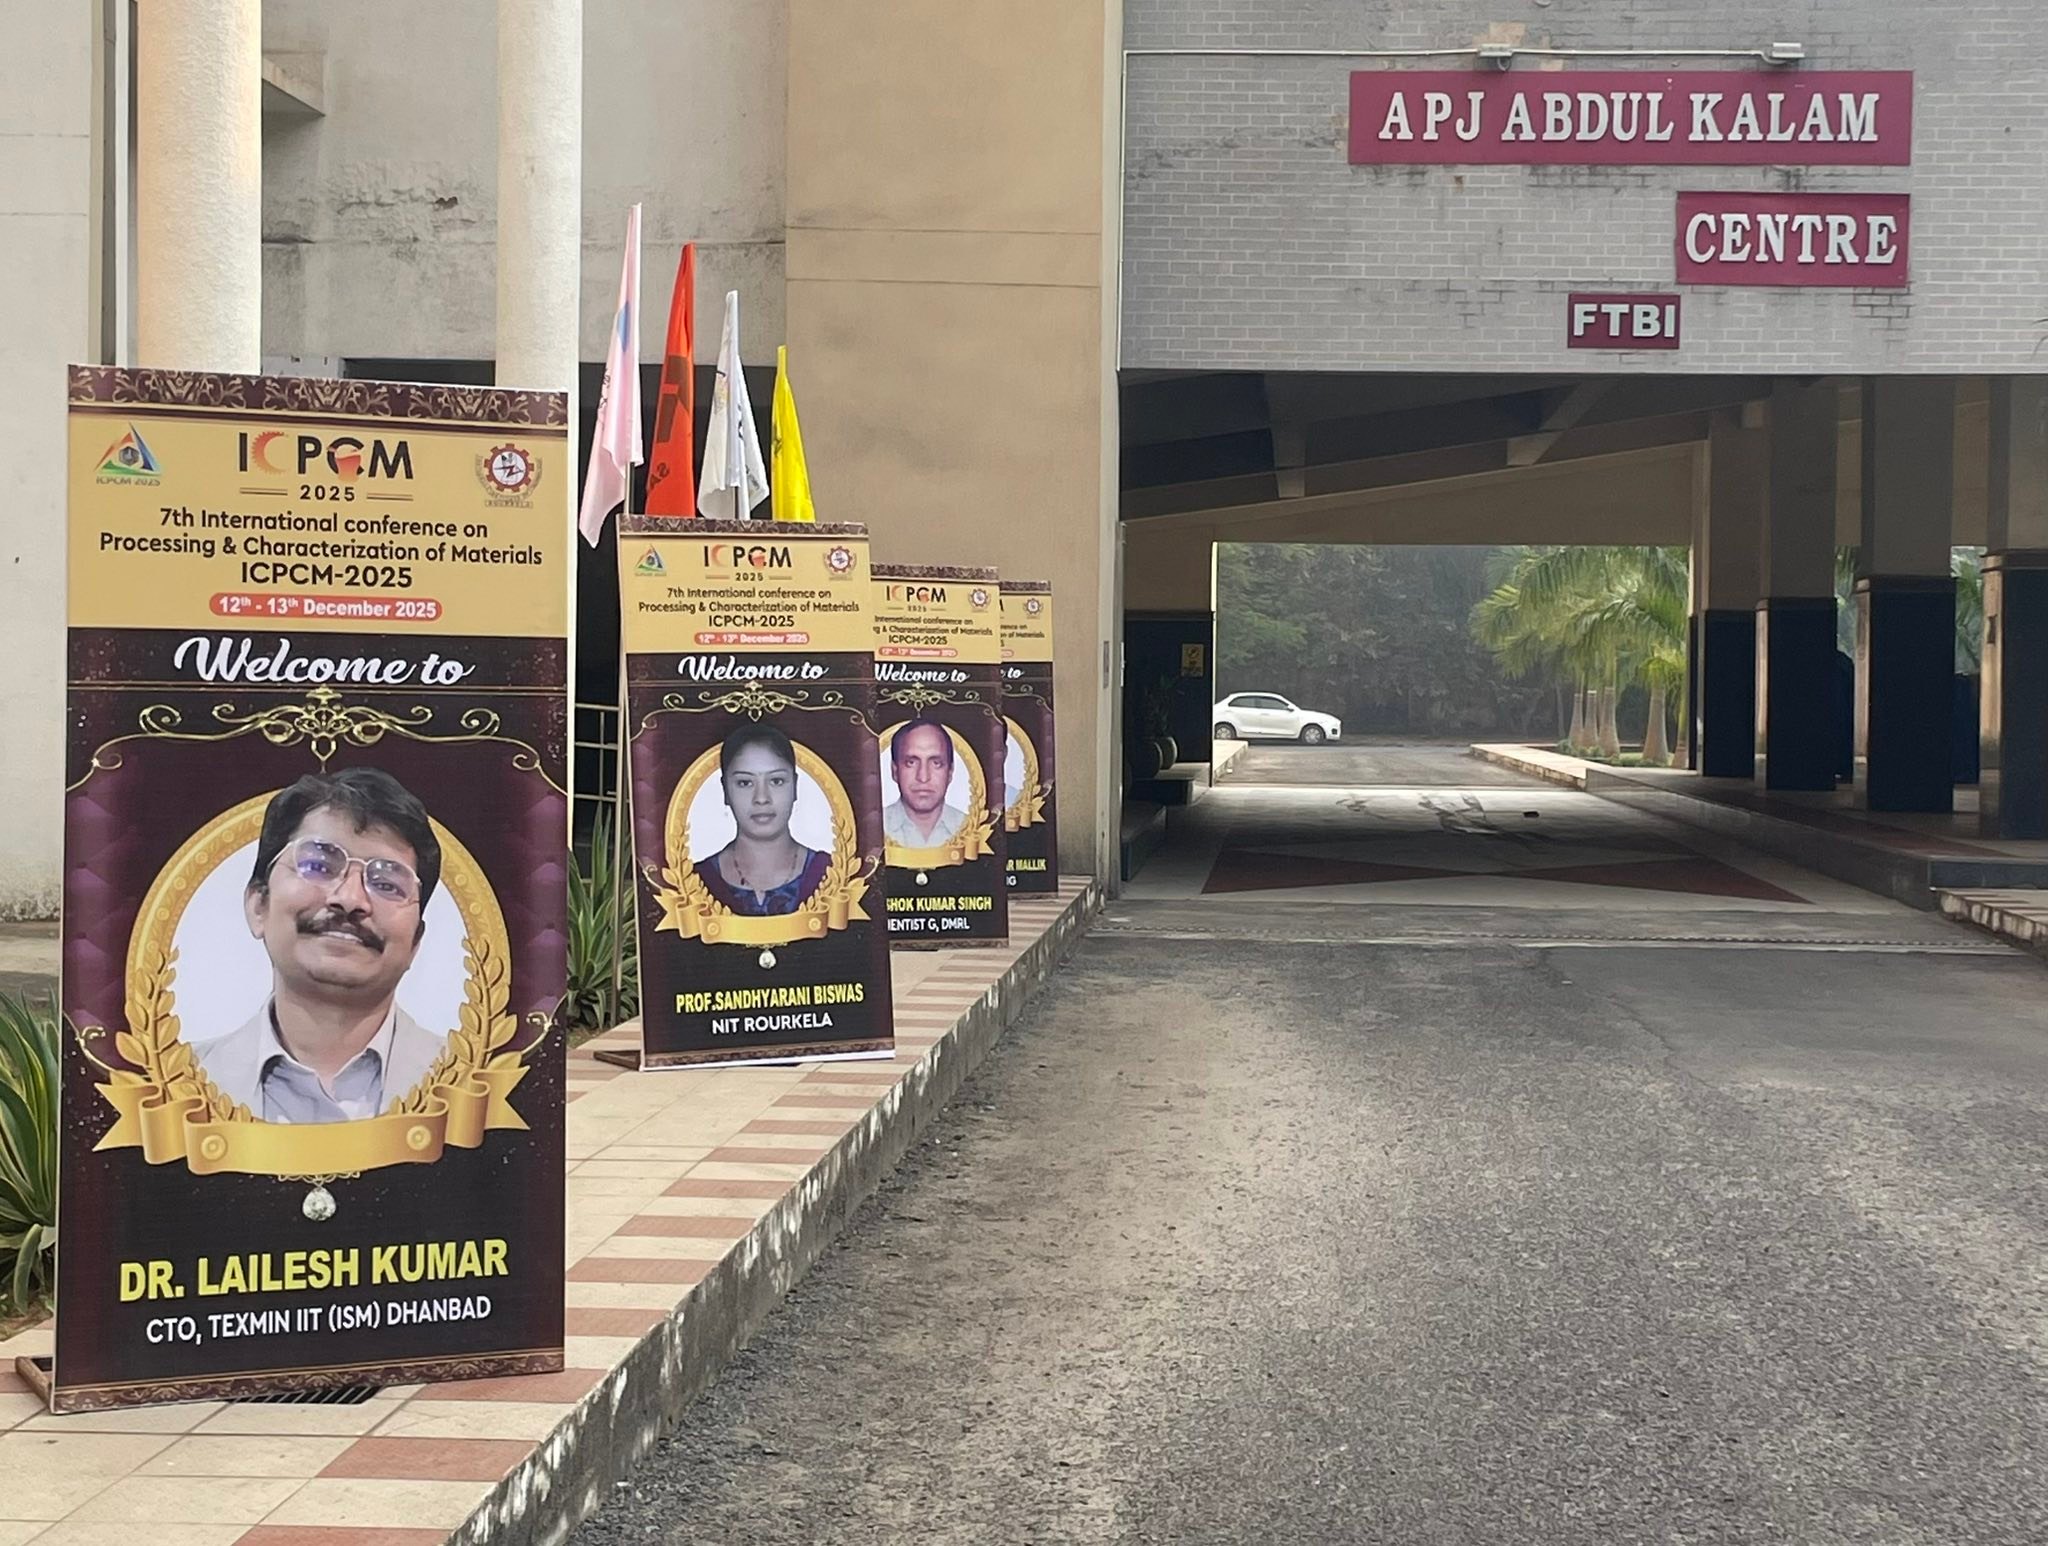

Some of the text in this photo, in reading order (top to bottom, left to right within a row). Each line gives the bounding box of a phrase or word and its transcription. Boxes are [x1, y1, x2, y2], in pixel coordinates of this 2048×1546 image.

[1378, 91, 1880, 143] APJ ABDUL KALAM
[1684, 213, 1898, 264] CENTRE
[1572, 303, 1676, 339] FTBI
[300, 485, 355, 502] 2025
[160, 507, 488, 538] 7th International conference on
[100, 532, 543, 565] Processing & Characterization of Materials
[241, 562, 413, 588] ICPCM-2025
[735, 572, 764, 582] 2025
[667, 587, 832, 599] 7th International conference on
[219, 596, 251, 614] 12th
[267, 597, 298, 615] 13th
[304, 598, 390, 617] December
[395, 601, 437, 618] 2025
[639, 601, 859, 614] Processing & Characterization of Materials
[709, 615, 795, 627] ICPCM-2025
[888, 634, 948, 645] ICPCM-2025
[174, 637, 476, 685] Welcome to
[677, 655, 829, 681] Welcome to
[874, 663, 970, 683] Welcome to
[886, 896, 992, 912] SHOK KUMAR SINGH
[887, 918, 926, 931] IENTIST
[941, 917, 970, 930] DMRL
[676, 983, 864, 1013] PROF.SANDHYARANI BISWAS
[712, 1012, 833, 1035] NIT ROURKELA
[120, 1239, 509, 1302] DR. LAILESH KUMAR
[146, 1295, 491, 1346] CTO, TEXMIN IIT (ISM) DHANBAD
